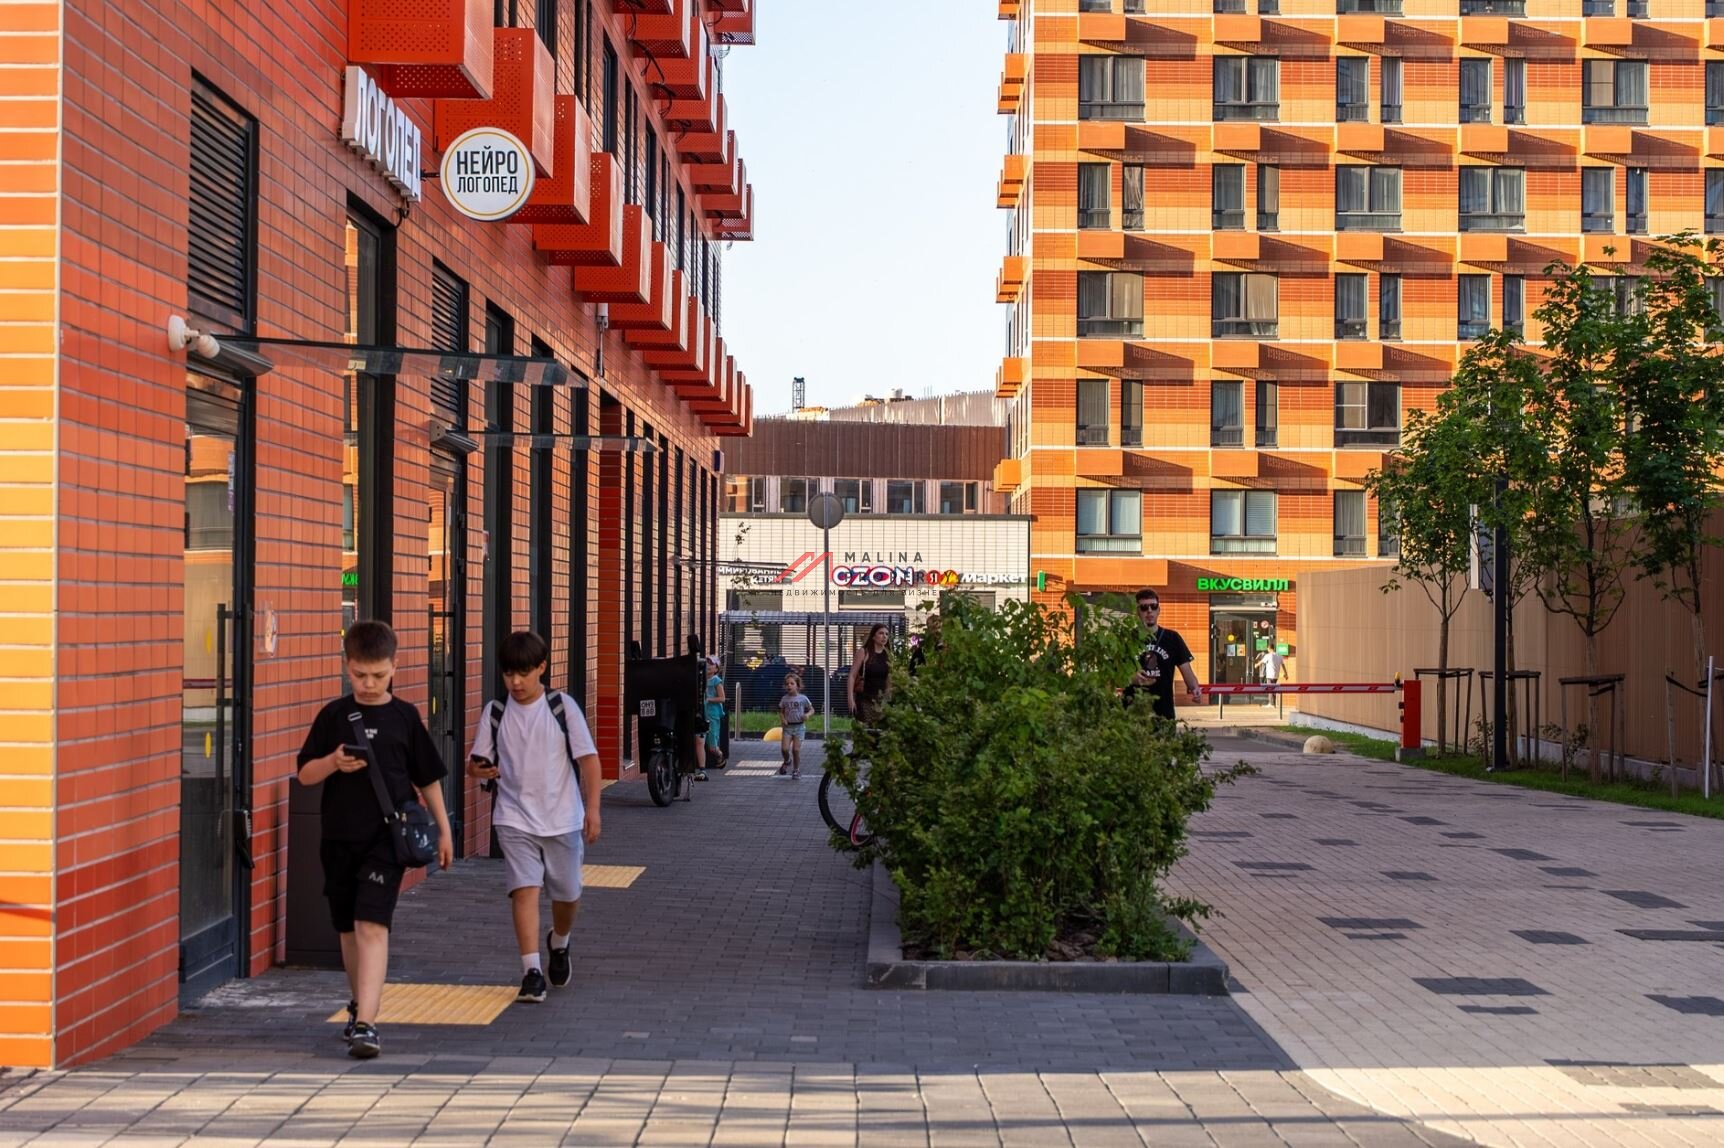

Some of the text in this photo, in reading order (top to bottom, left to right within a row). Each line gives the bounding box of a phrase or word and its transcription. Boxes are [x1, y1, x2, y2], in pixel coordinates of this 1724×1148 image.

[345, 66, 422, 202] ЛОГОПЕД
[456, 145, 518, 175] НЕЙРО
[457, 176, 519, 195] ЛОГОПЕД
[832, 565, 915, 587] OZON
[961, 573, 1027, 585] Маркет
[1197, 577, 1289, 592] ВКУСВИЛЛ
